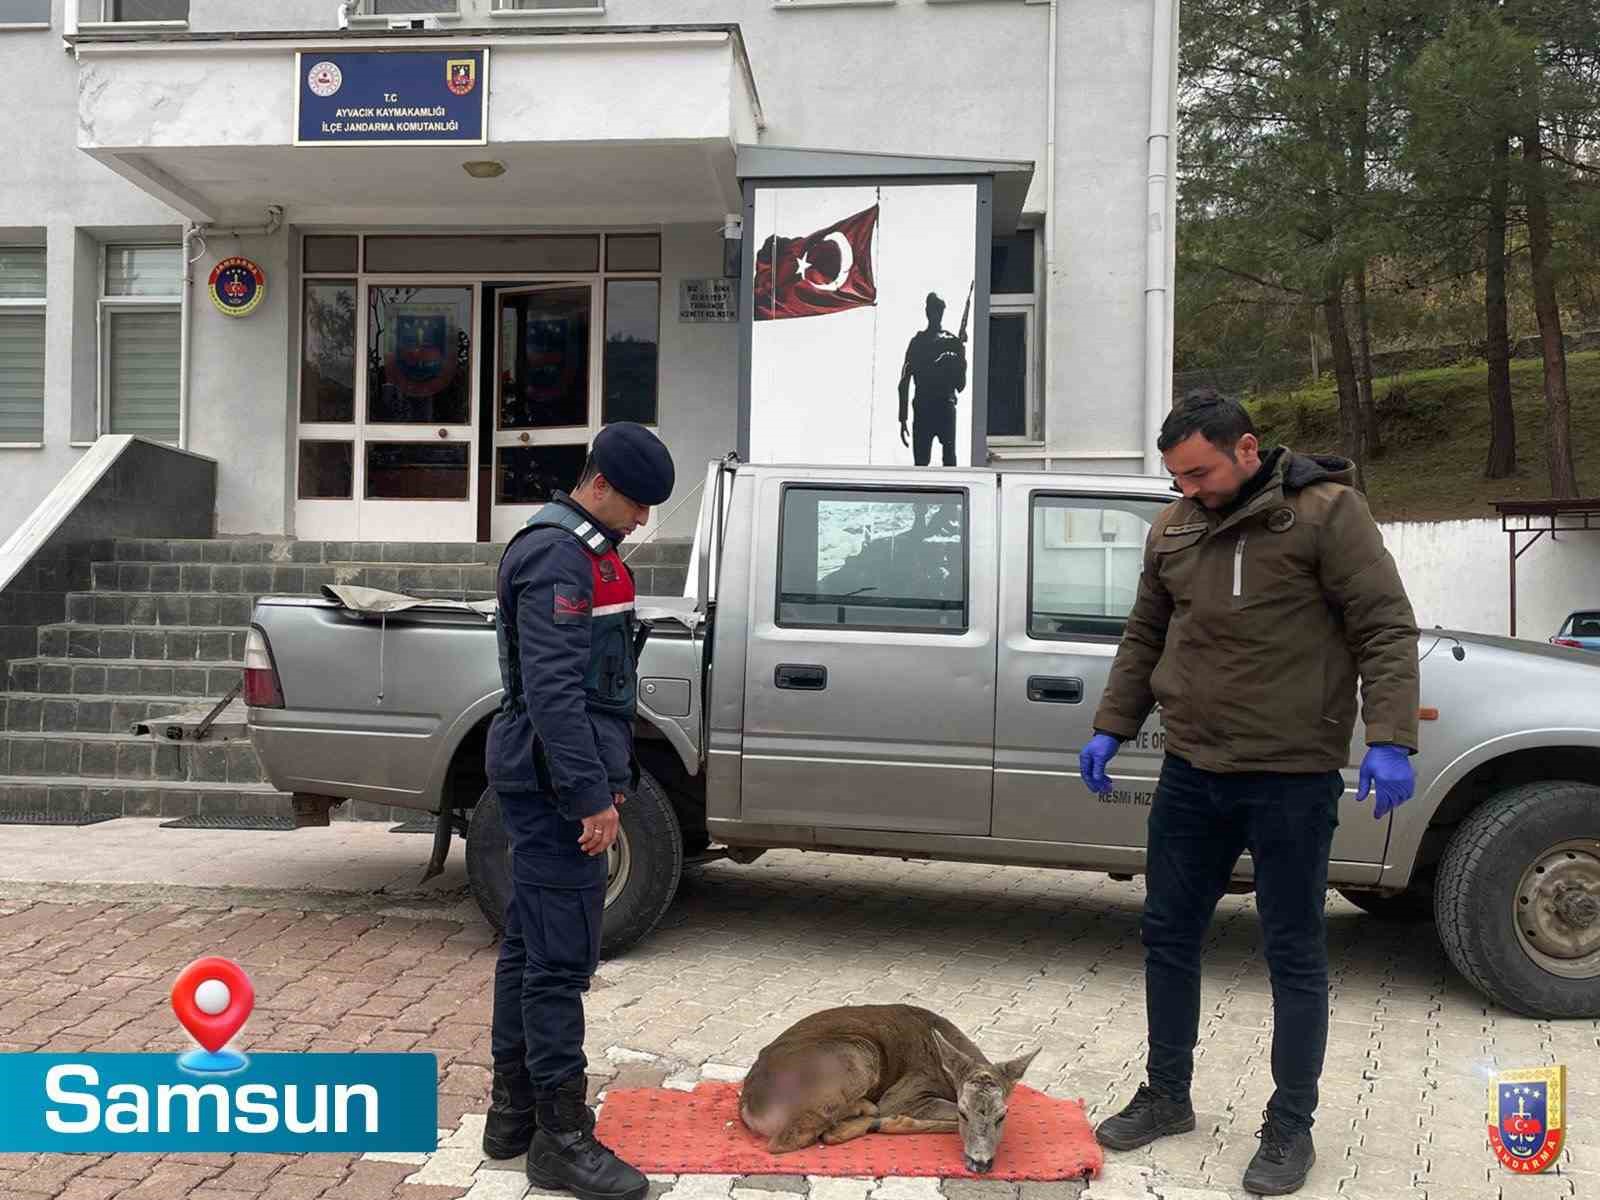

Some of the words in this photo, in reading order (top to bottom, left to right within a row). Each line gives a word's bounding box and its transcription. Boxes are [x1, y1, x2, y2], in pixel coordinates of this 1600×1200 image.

[335, 107, 375, 118] AYVACIK
[376, 105, 446, 117] KAYMAKAMLIĞI
[321, 121, 343, 133] İLÇE
[344, 121, 395, 132] JANDARMA
[396, 120, 459, 132] KOMUTANLIĞI
